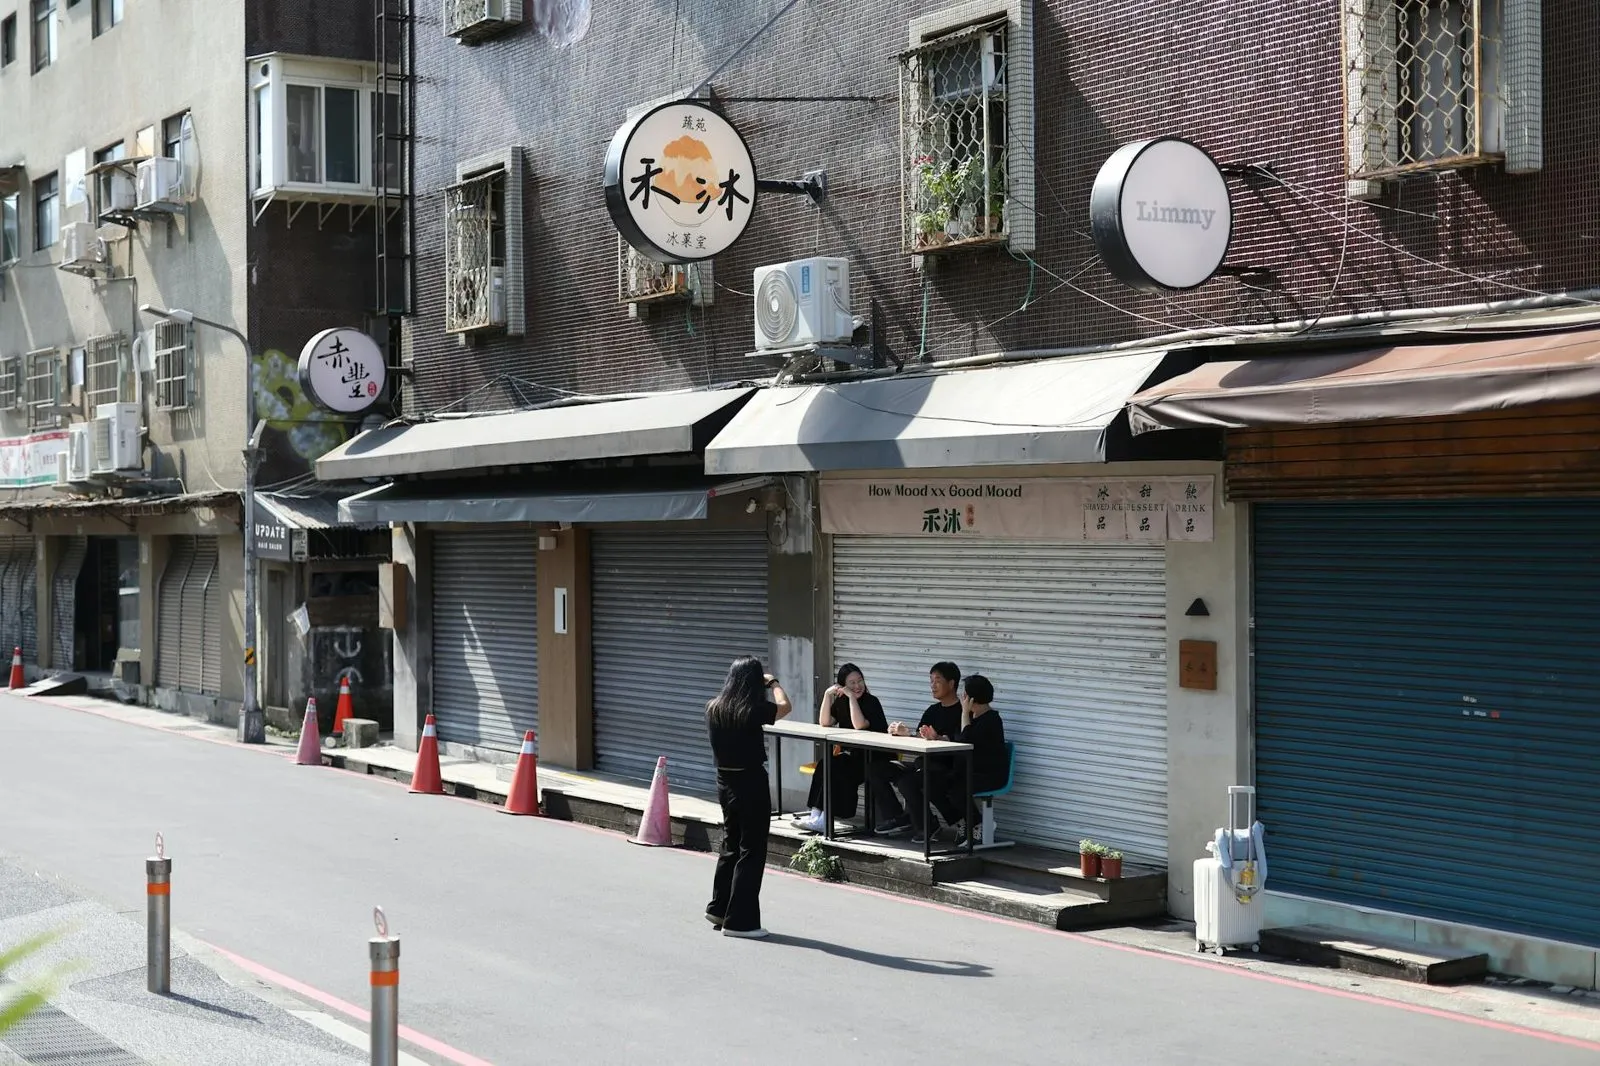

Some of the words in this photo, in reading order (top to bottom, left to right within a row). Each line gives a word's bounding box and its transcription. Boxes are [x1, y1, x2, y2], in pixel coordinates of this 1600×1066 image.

[681, 115, 707, 132] 蔬苑
[1136, 200, 1216, 230] Limmy
[868, 484, 892, 497] How
[895, 484, 928, 497] Mood
[949, 484, 983, 498] Good
[985, 484, 1022, 498] Mood
[1175, 503, 1206, 512] DRINK
[255, 524, 285, 539] UPDATE
